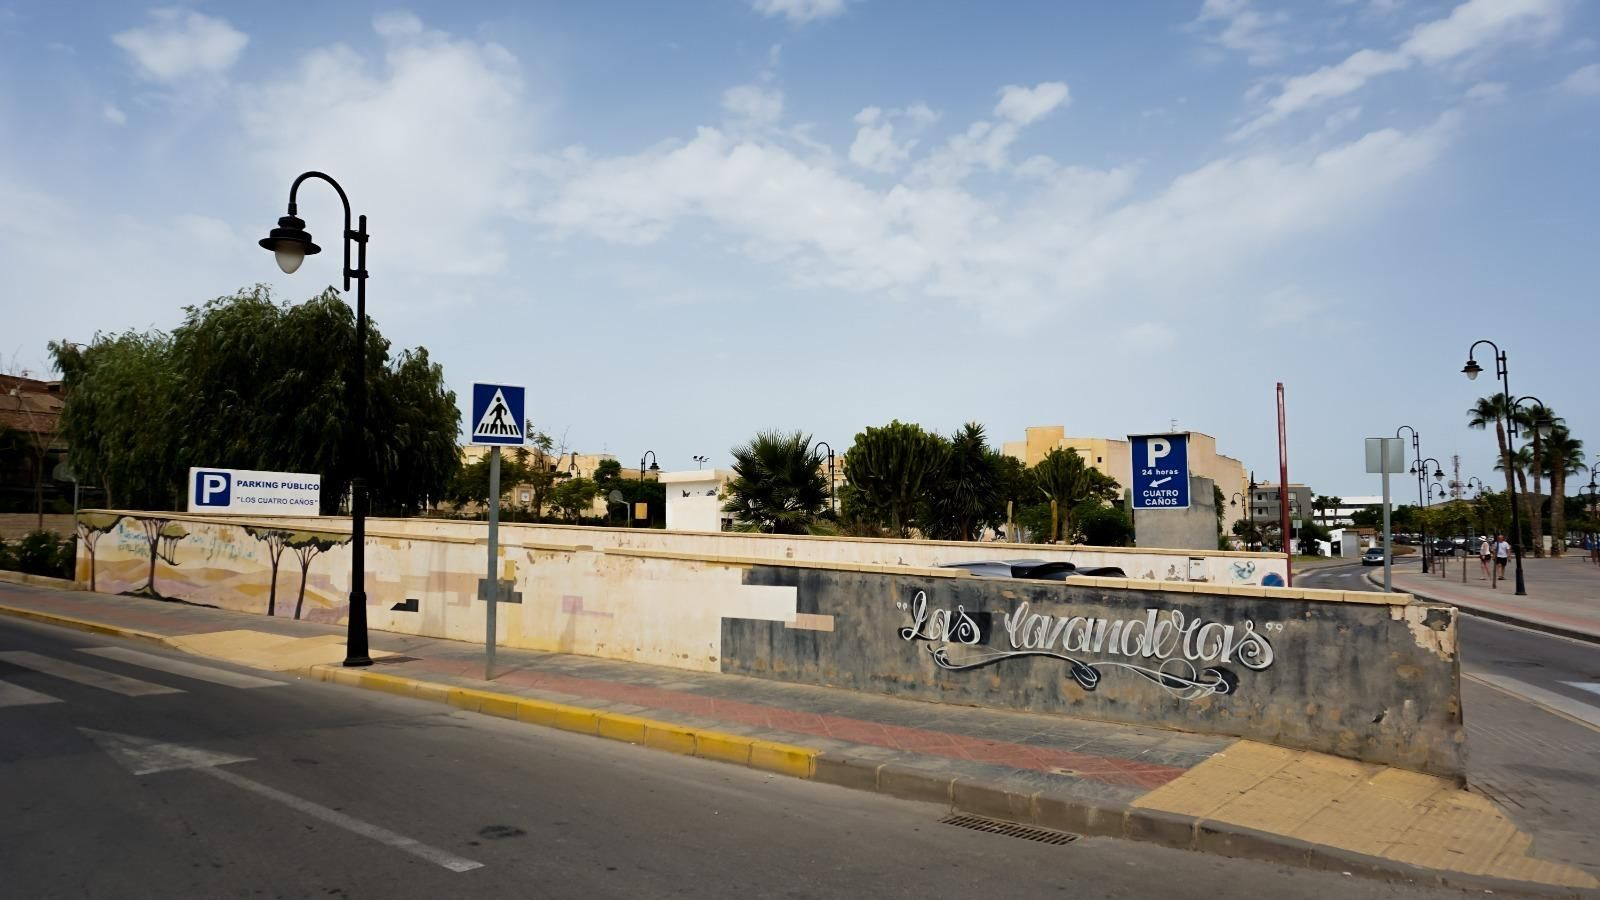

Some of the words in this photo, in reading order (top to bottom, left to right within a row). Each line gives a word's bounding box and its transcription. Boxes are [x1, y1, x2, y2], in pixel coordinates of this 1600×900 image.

[1147, 438, 1171, 467] P
[202, 474, 227, 504] P
[236, 480, 279, 489] PARKING
[281, 480, 320, 491] PÚBLICO
[1143, 489, 1179, 497] CUATRO
[236, 496, 256, 504] "LOS
[257, 497, 288, 505] CUATRO
[289, 498, 319, 506] CAÑOS"
[1145, 497, 1178, 506] CAÑOS
